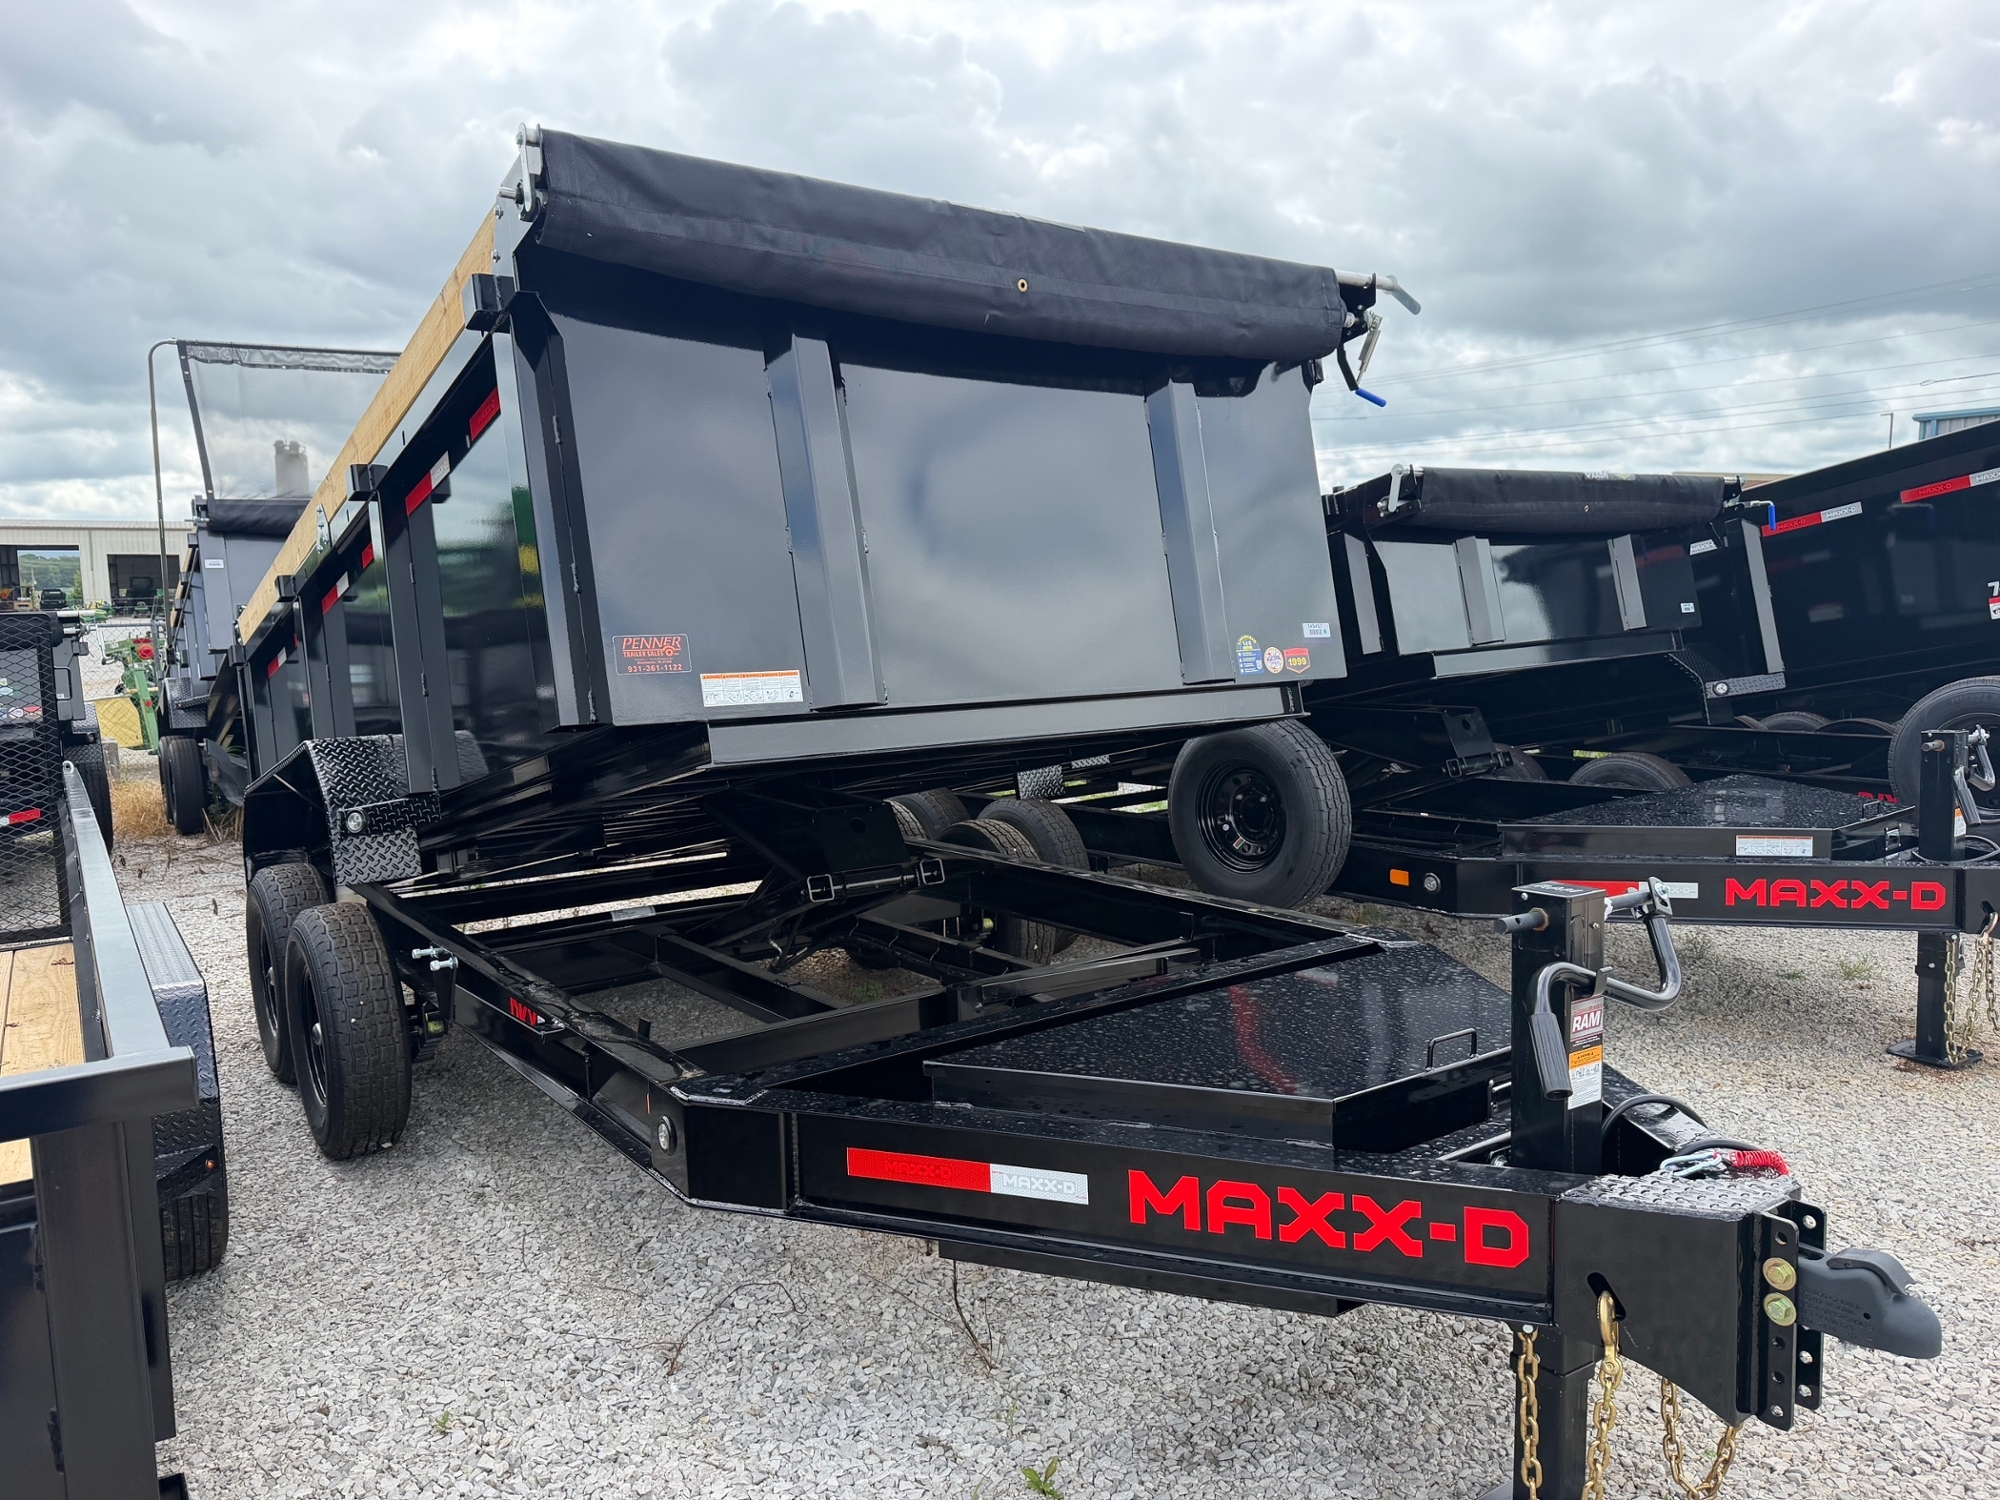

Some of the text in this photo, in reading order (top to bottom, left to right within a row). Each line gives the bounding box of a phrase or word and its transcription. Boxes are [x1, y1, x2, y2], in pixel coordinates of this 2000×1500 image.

[1918, 483, 1952, 496] MAXX-D
[1826, 506, 1856, 519] MAXX-D
[1777, 518, 1806, 530] MAXX-D
[622, 636, 682, 650] PENNER
[623, 650, 664, 658] TRAILER SALES
[627, 663, 683, 673] 931-361-1122
[1288, 657, 1307, 666] 1999
[1725, 878, 1946, 910] MAXX-D
[1572, 1010, 1602, 1033] RAM
[884, 1160, 952, 1180] MAXX-D
[1003, 1174, 1076, 1195] MAXX-D
[1128, 1169, 1530, 1269] MAXX-D
